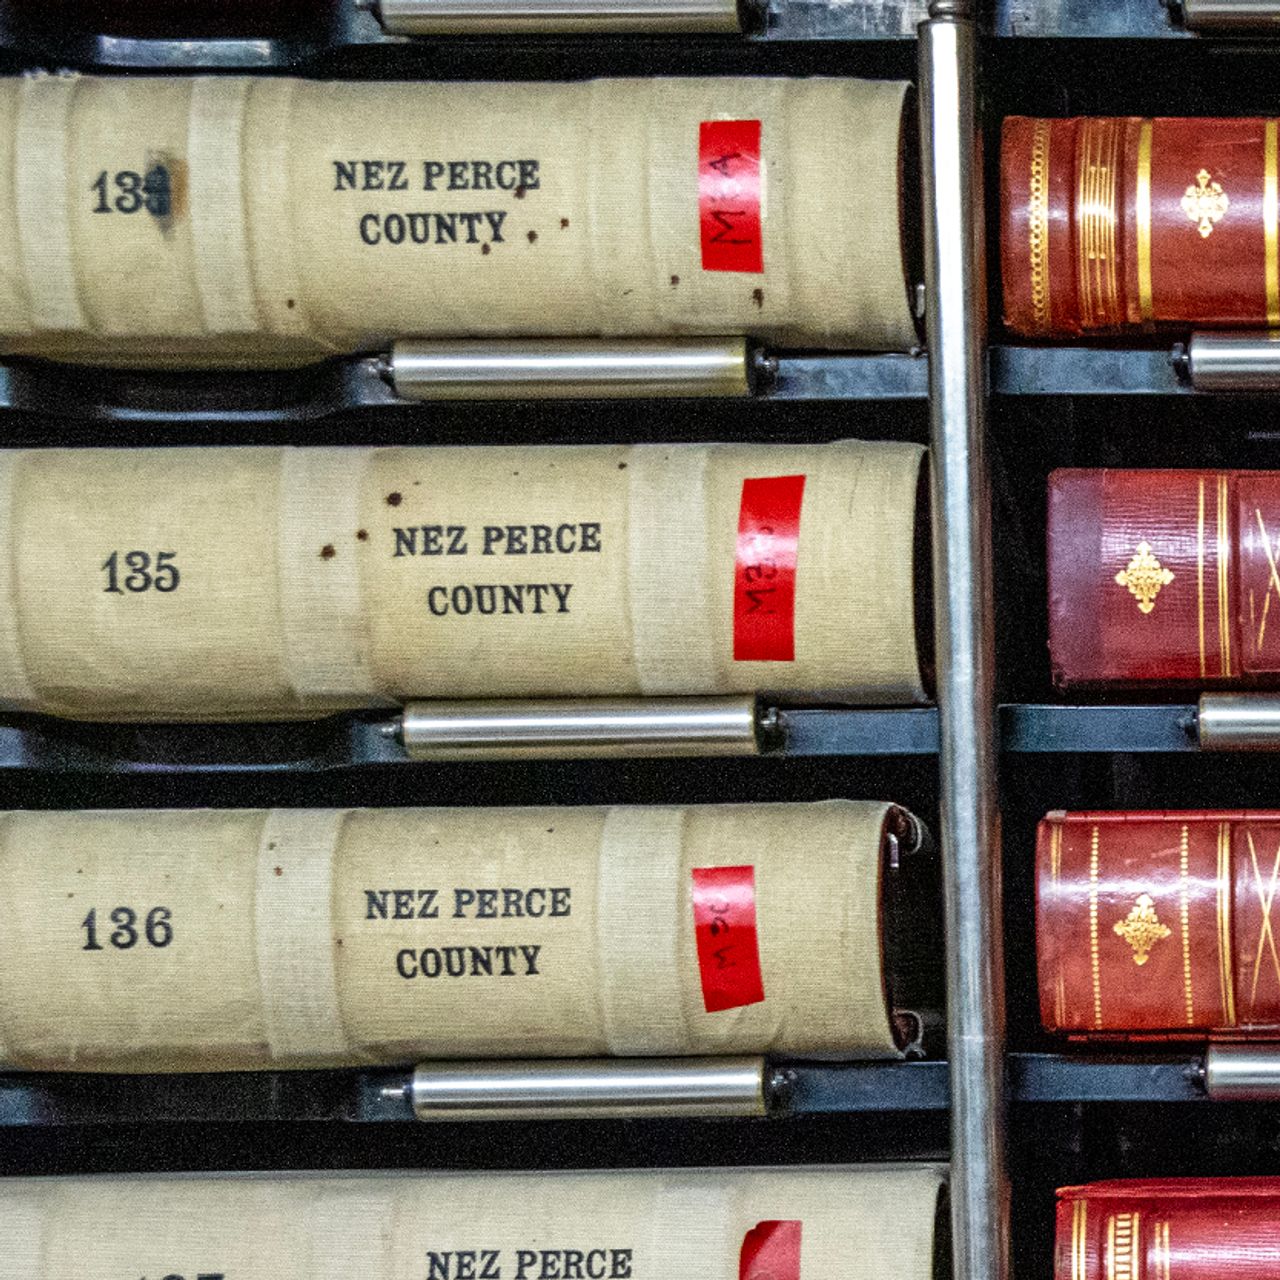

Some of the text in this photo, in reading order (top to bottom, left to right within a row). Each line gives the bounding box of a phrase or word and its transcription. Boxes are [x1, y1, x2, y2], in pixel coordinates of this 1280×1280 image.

[90, 164, 171, 217] 13
[333, 160, 540, 191] NEZ PERCE
[359, 213, 506, 245] COUNTY
[392, 522, 601, 557] NEZ PERCE
[101, 552, 181, 593] 135
[428, 585, 572, 616] COUNTY
[364, 888, 571, 921] NEZ PERCE
[80, 907, 174, 950] 136
[397, 946, 541, 979] COUNTY
[515, 1250, 633, 1280] PERCE
